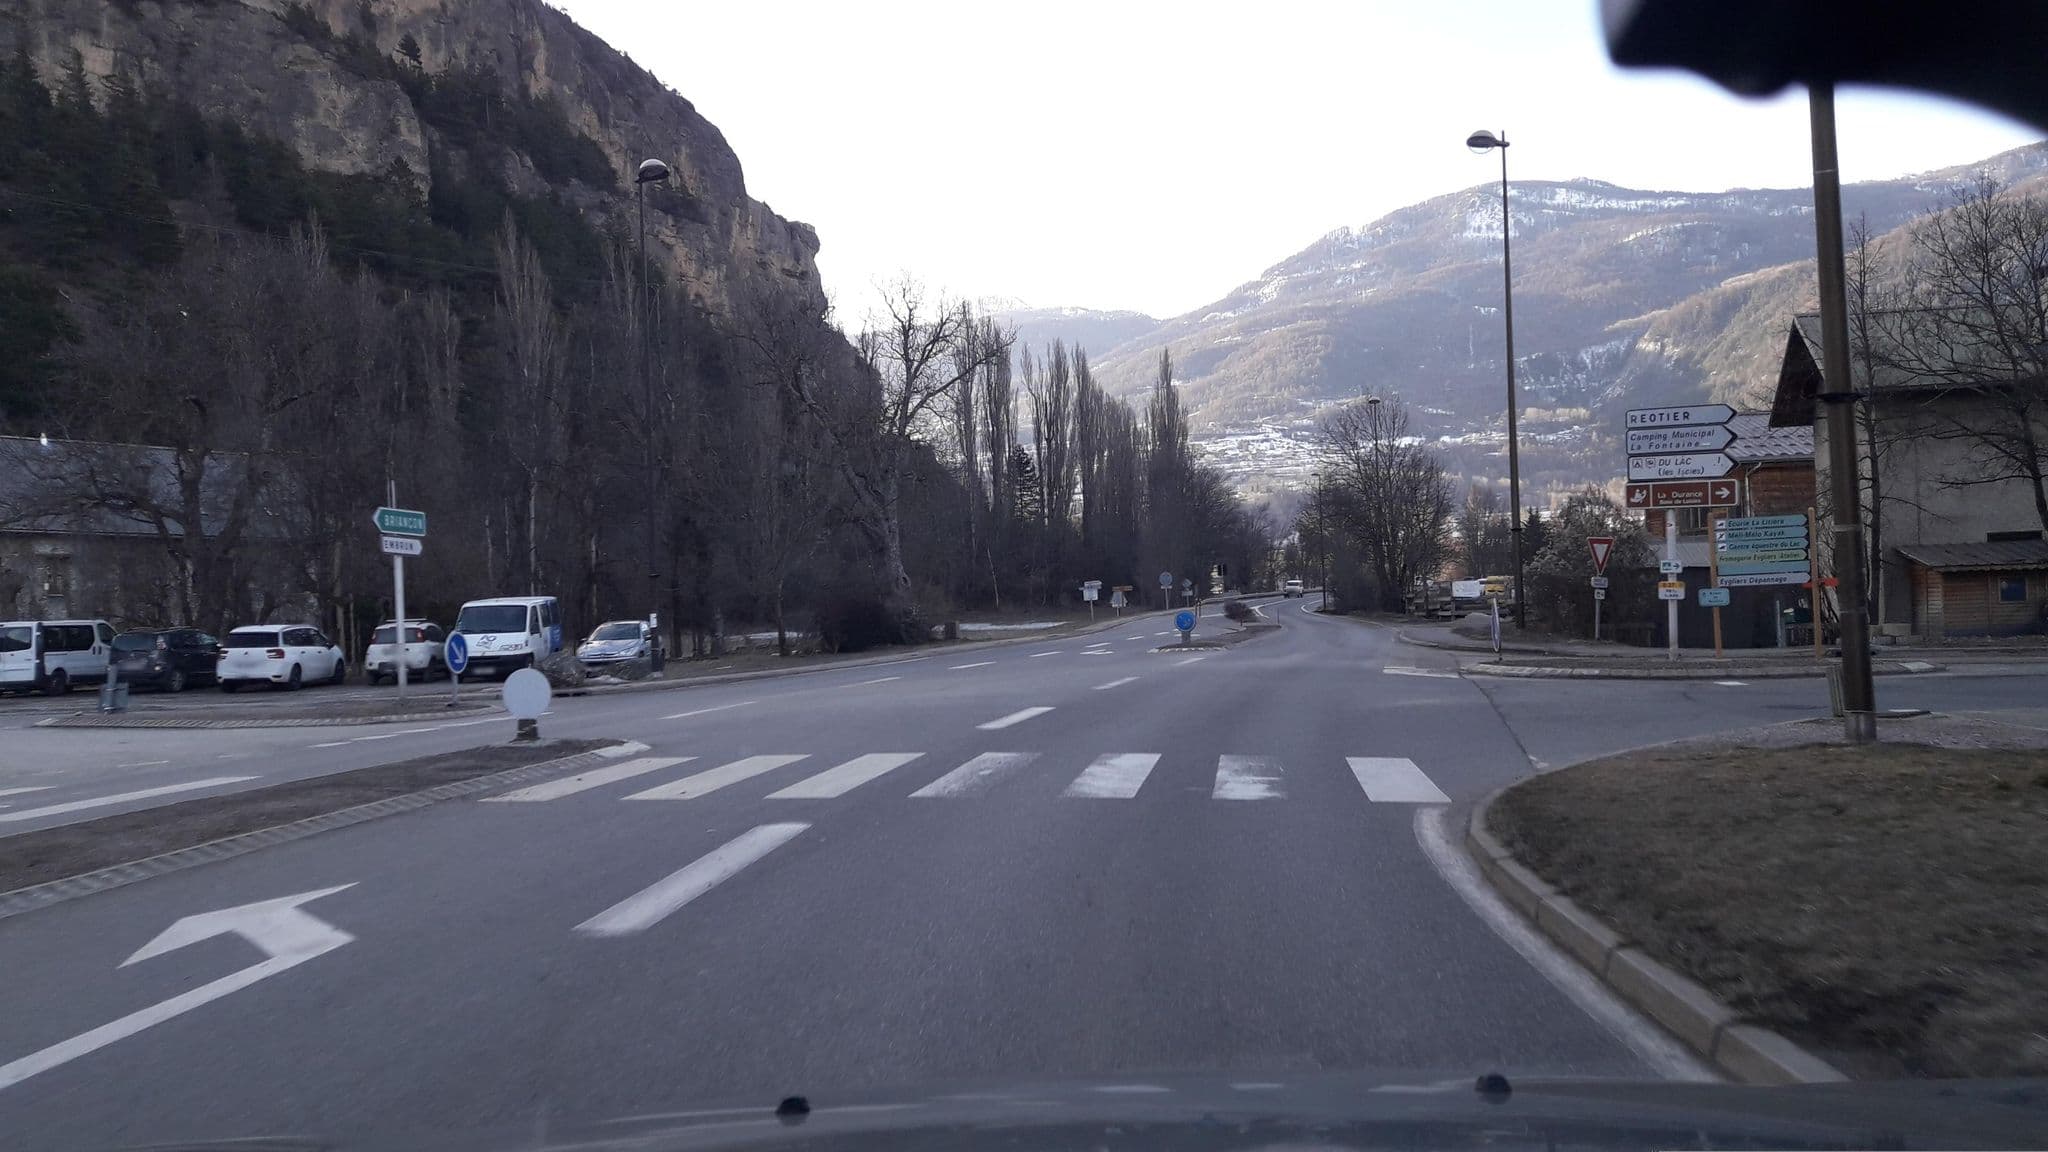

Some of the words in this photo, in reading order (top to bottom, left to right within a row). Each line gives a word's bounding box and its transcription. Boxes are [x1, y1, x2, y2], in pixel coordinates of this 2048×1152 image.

[1631, 411, 1690, 423] REOTIER
[1630, 432, 1668, 442] Camping
[1672, 429, 1715, 439] Municipal
[1649, 441, 1700, 450] Fontaine
[1658, 458, 1671, 466] DU
[1675, 457, 1692, 466] LAC
[1671, 490, 1703, 499] Durance
[384, 539, 414, 551] EMBRUN
[1719, 577, 1747, 586] Eygliers
